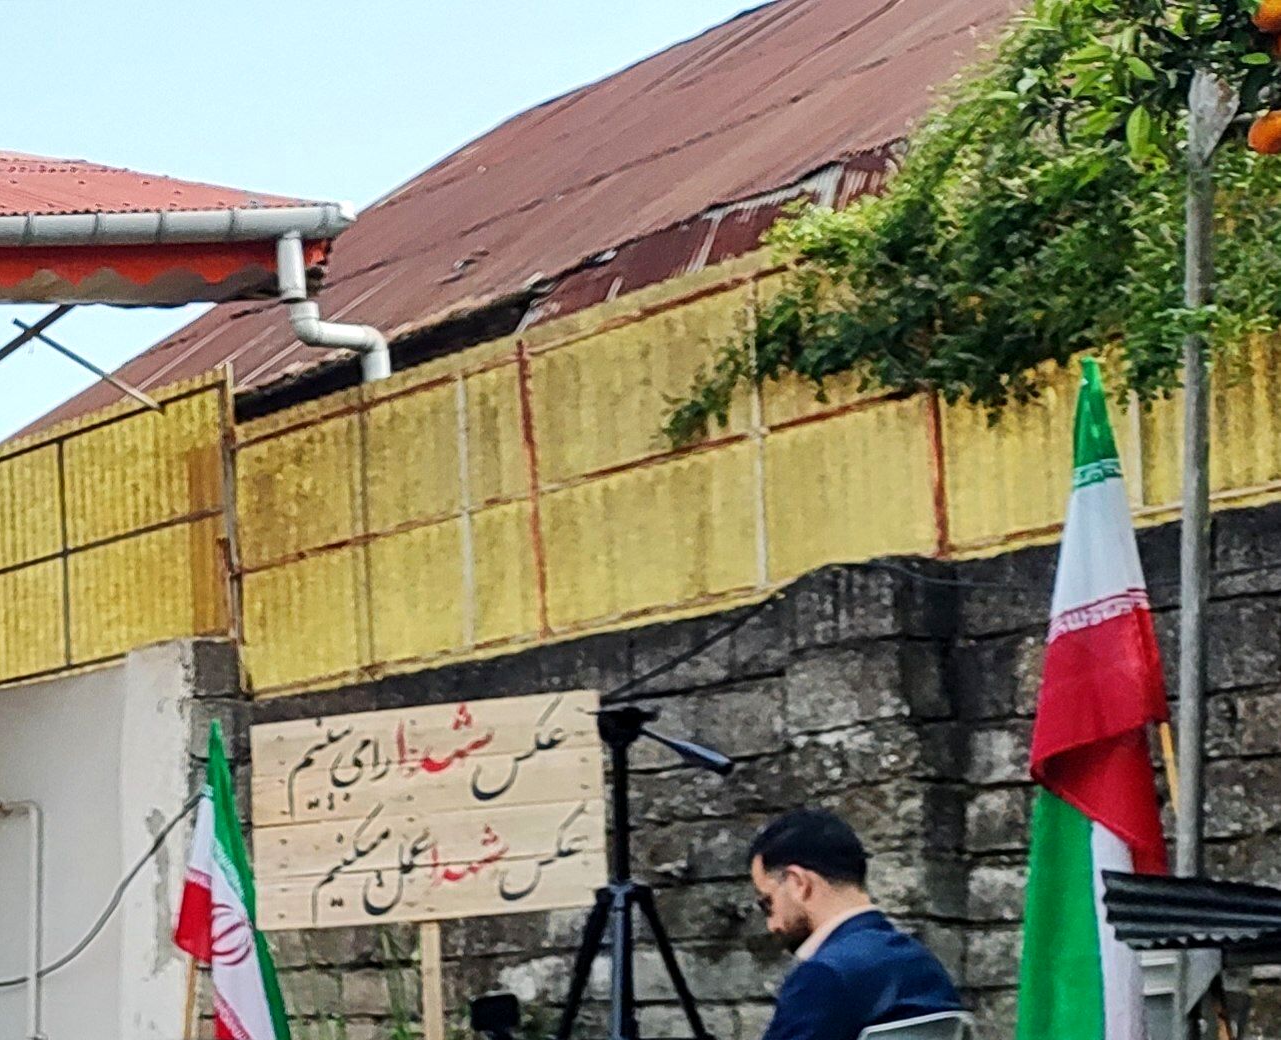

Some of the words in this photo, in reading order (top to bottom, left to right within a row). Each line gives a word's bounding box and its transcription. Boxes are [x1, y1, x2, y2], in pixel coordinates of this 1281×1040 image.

[397, 702, 495, 779] شهدا
[471, 695, 568, 801] عکس
[362, 827, 432, 915] عمل
[431, 822, 510, 888] شهدا
[499, 801, 589, 901] عکس
